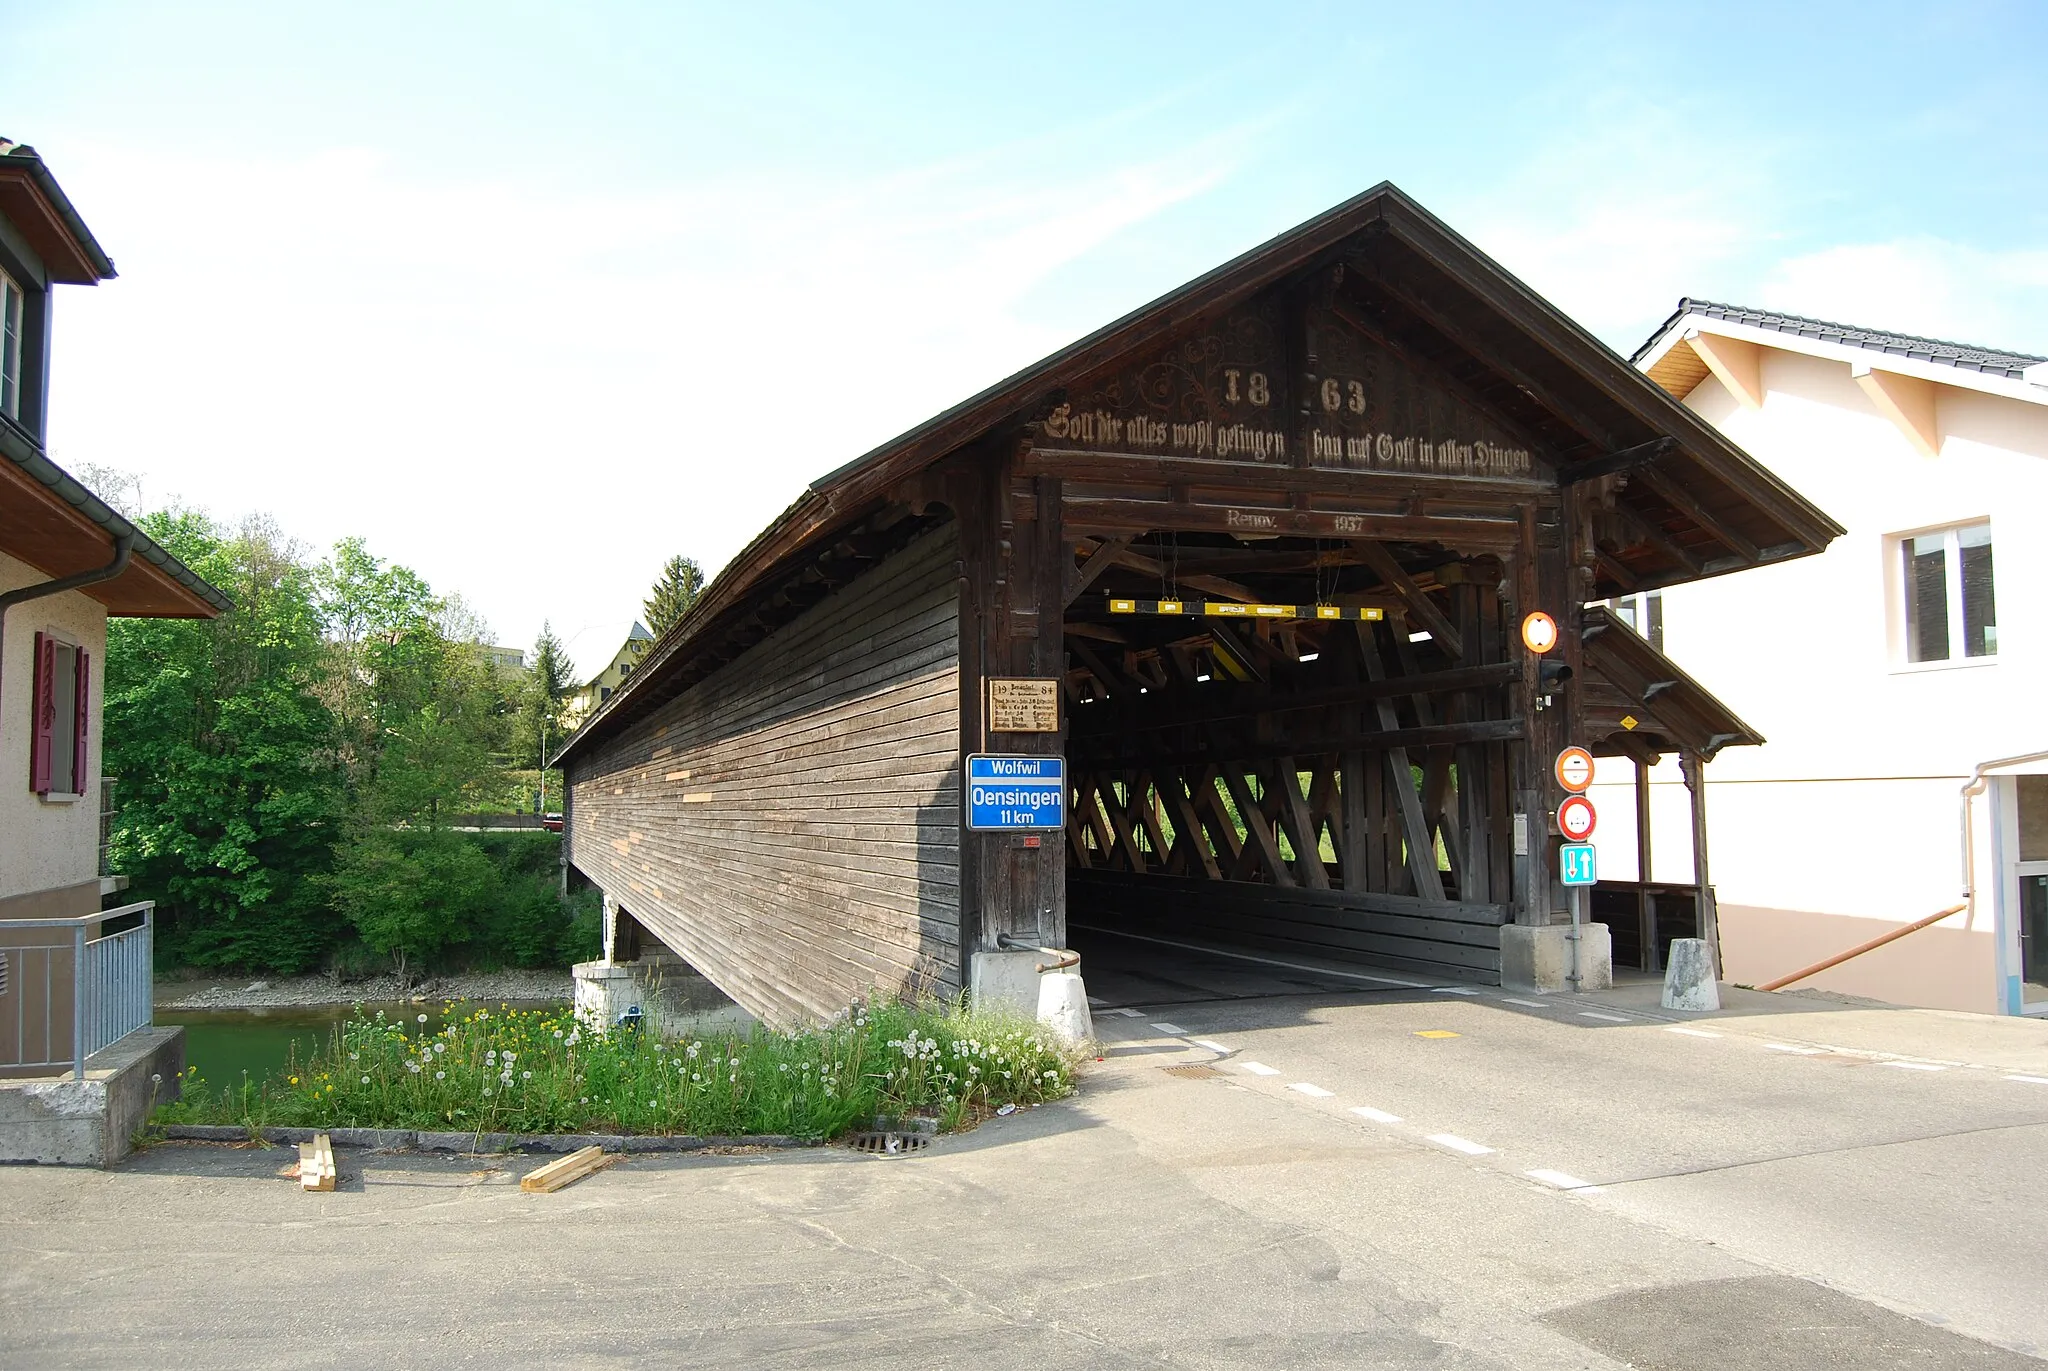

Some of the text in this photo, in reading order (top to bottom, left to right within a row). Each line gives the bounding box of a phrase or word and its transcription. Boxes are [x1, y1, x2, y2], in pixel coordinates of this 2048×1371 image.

[1044, 403, 1094, 442] Soll
[1127, 415, 1167, 446] alles
[1172, 420, 1213, 454] wohl
[1217, 424, 1285, 461] gelingen
[1347, 433, 1373, 463] auf
[1376, 432, 1415, 464] Gott
[1420, 437, 1434, 465] in
[1438, 439, 1474, 468] allen
[1474, 441, 1531, 474] Dingen
[1227, 510, 1364, 532] Renov. 1937
[991, 760, 1041, 775] Wolfwil
[972, 787, 1061, 810] Oensingen
[1000, 811, 1035, 824] 11 km
